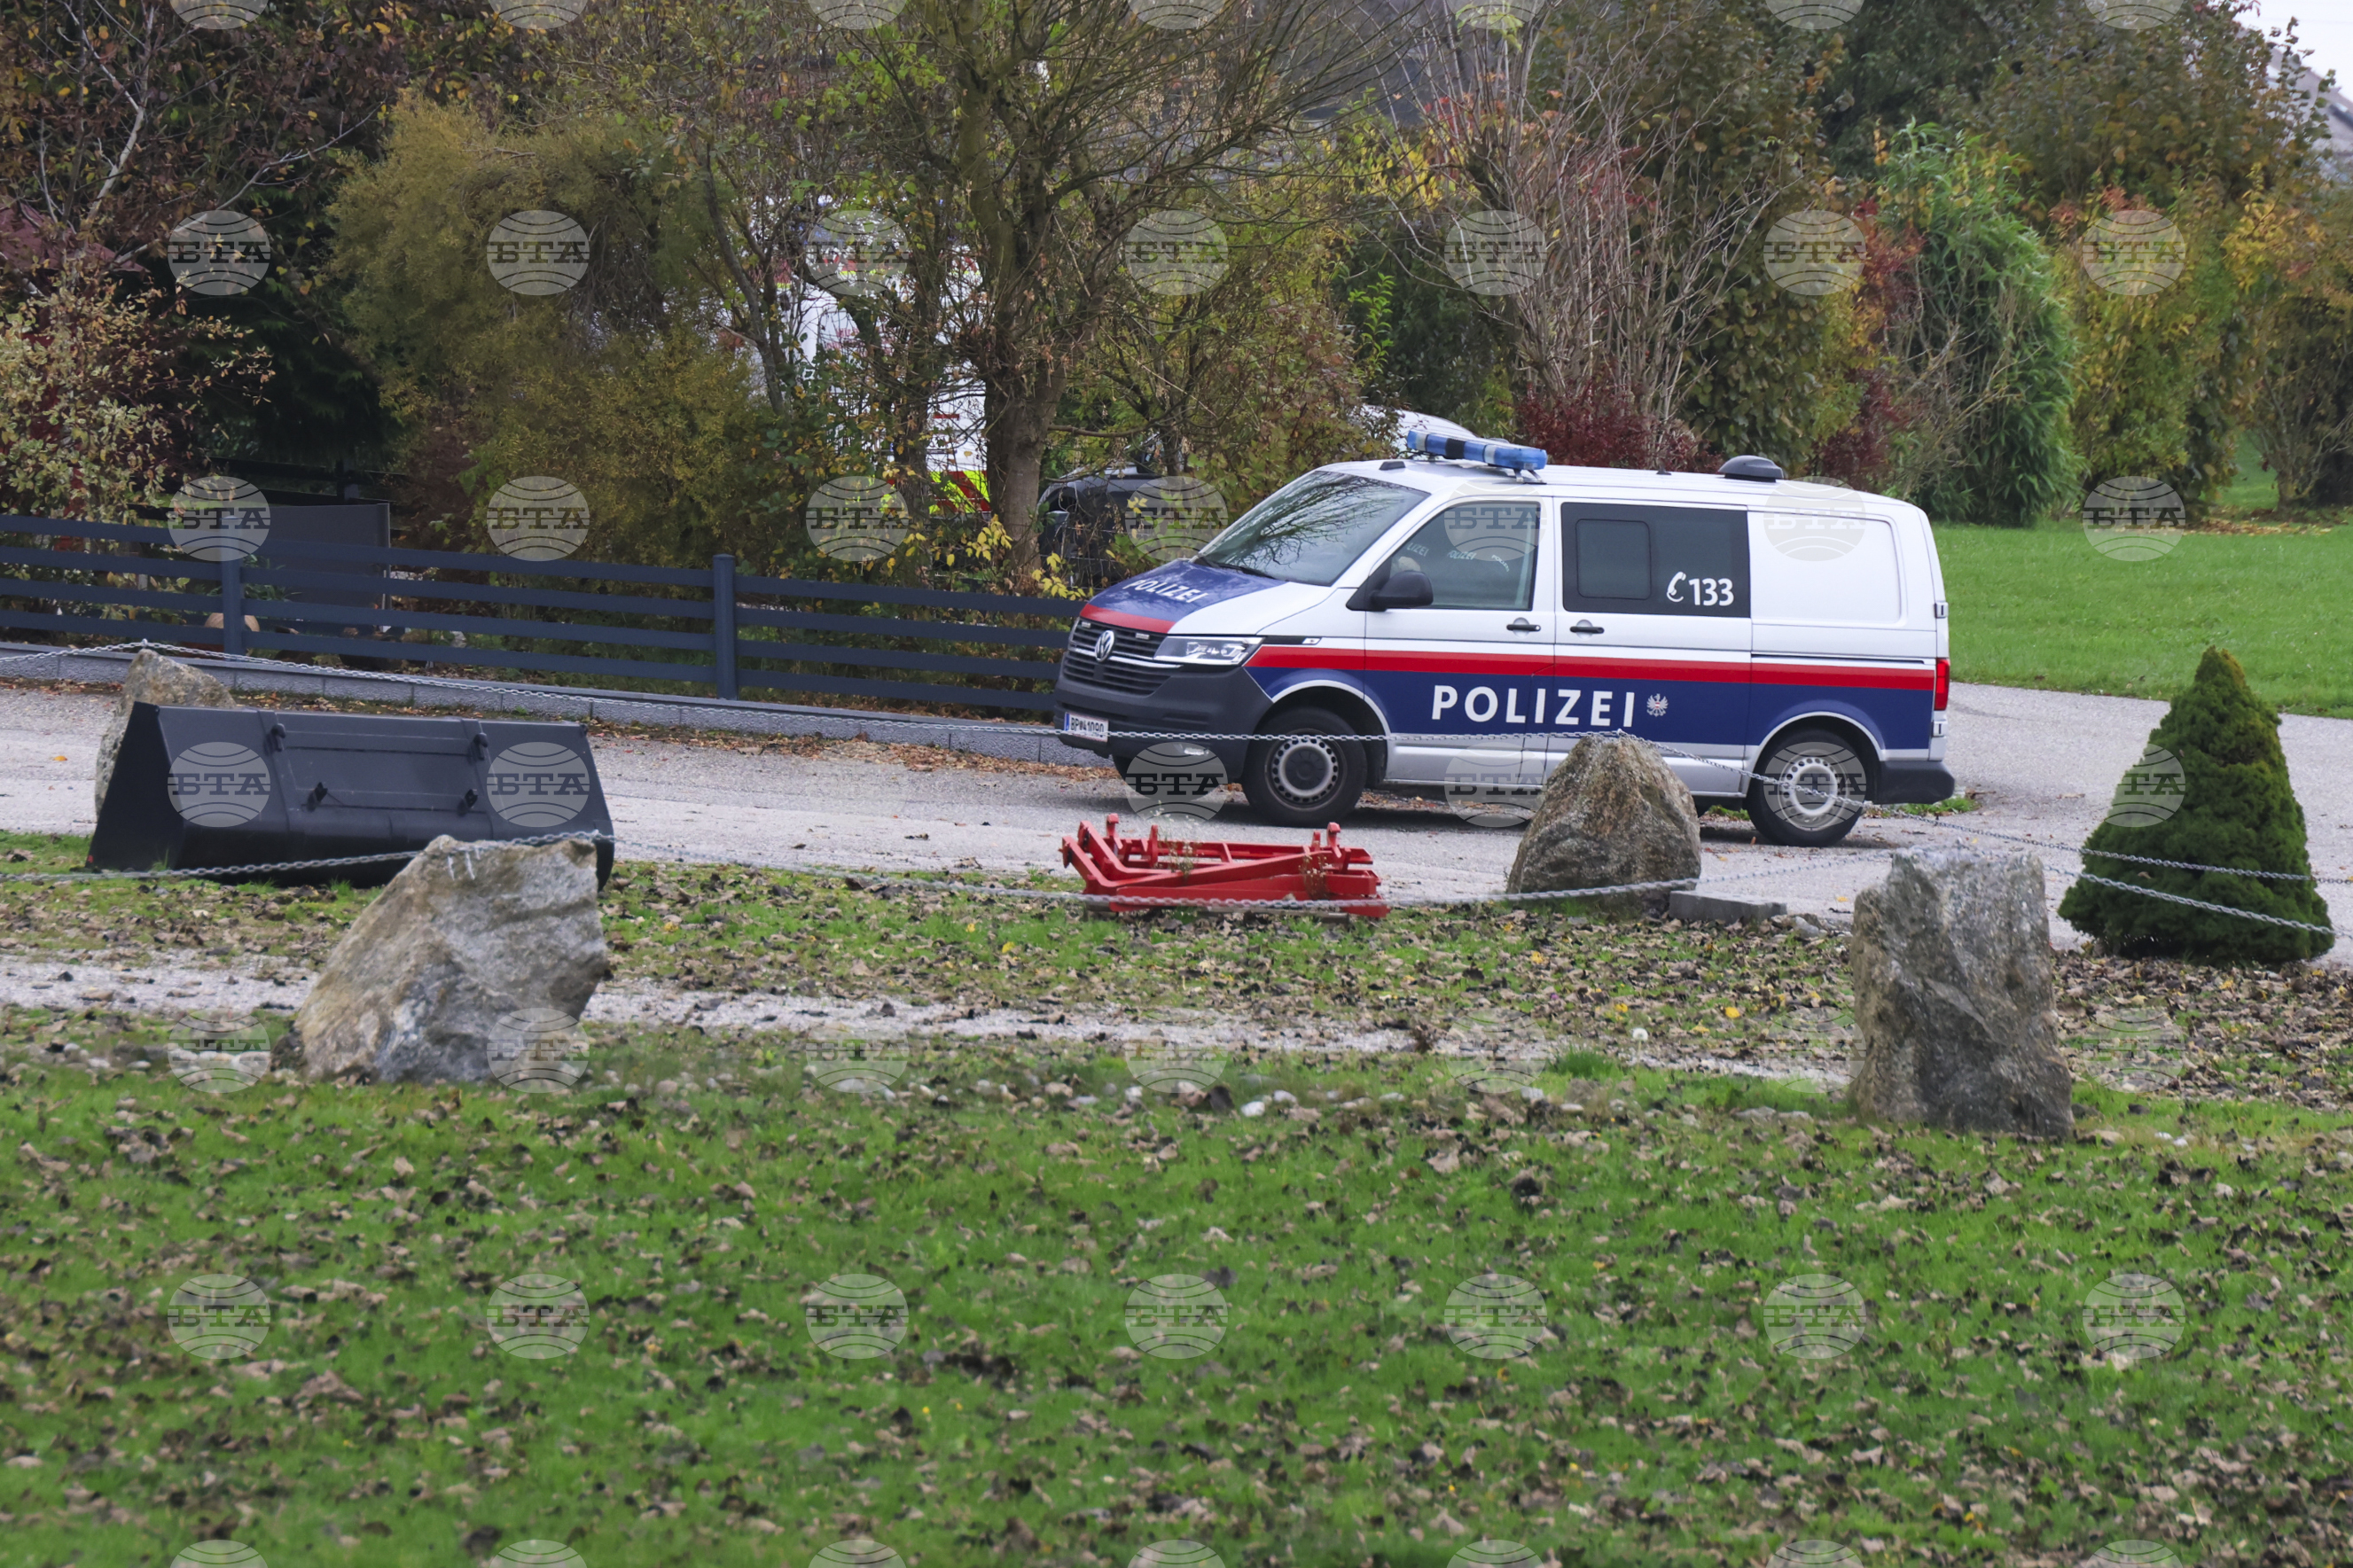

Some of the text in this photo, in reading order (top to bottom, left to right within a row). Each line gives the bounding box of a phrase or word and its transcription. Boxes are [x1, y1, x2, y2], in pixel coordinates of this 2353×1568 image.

[1122, 579, 1209, 604] POLIZEI
[1688, 578, 1735, 607] 133
[1431, 684, 1636, 728] POLIZEI
